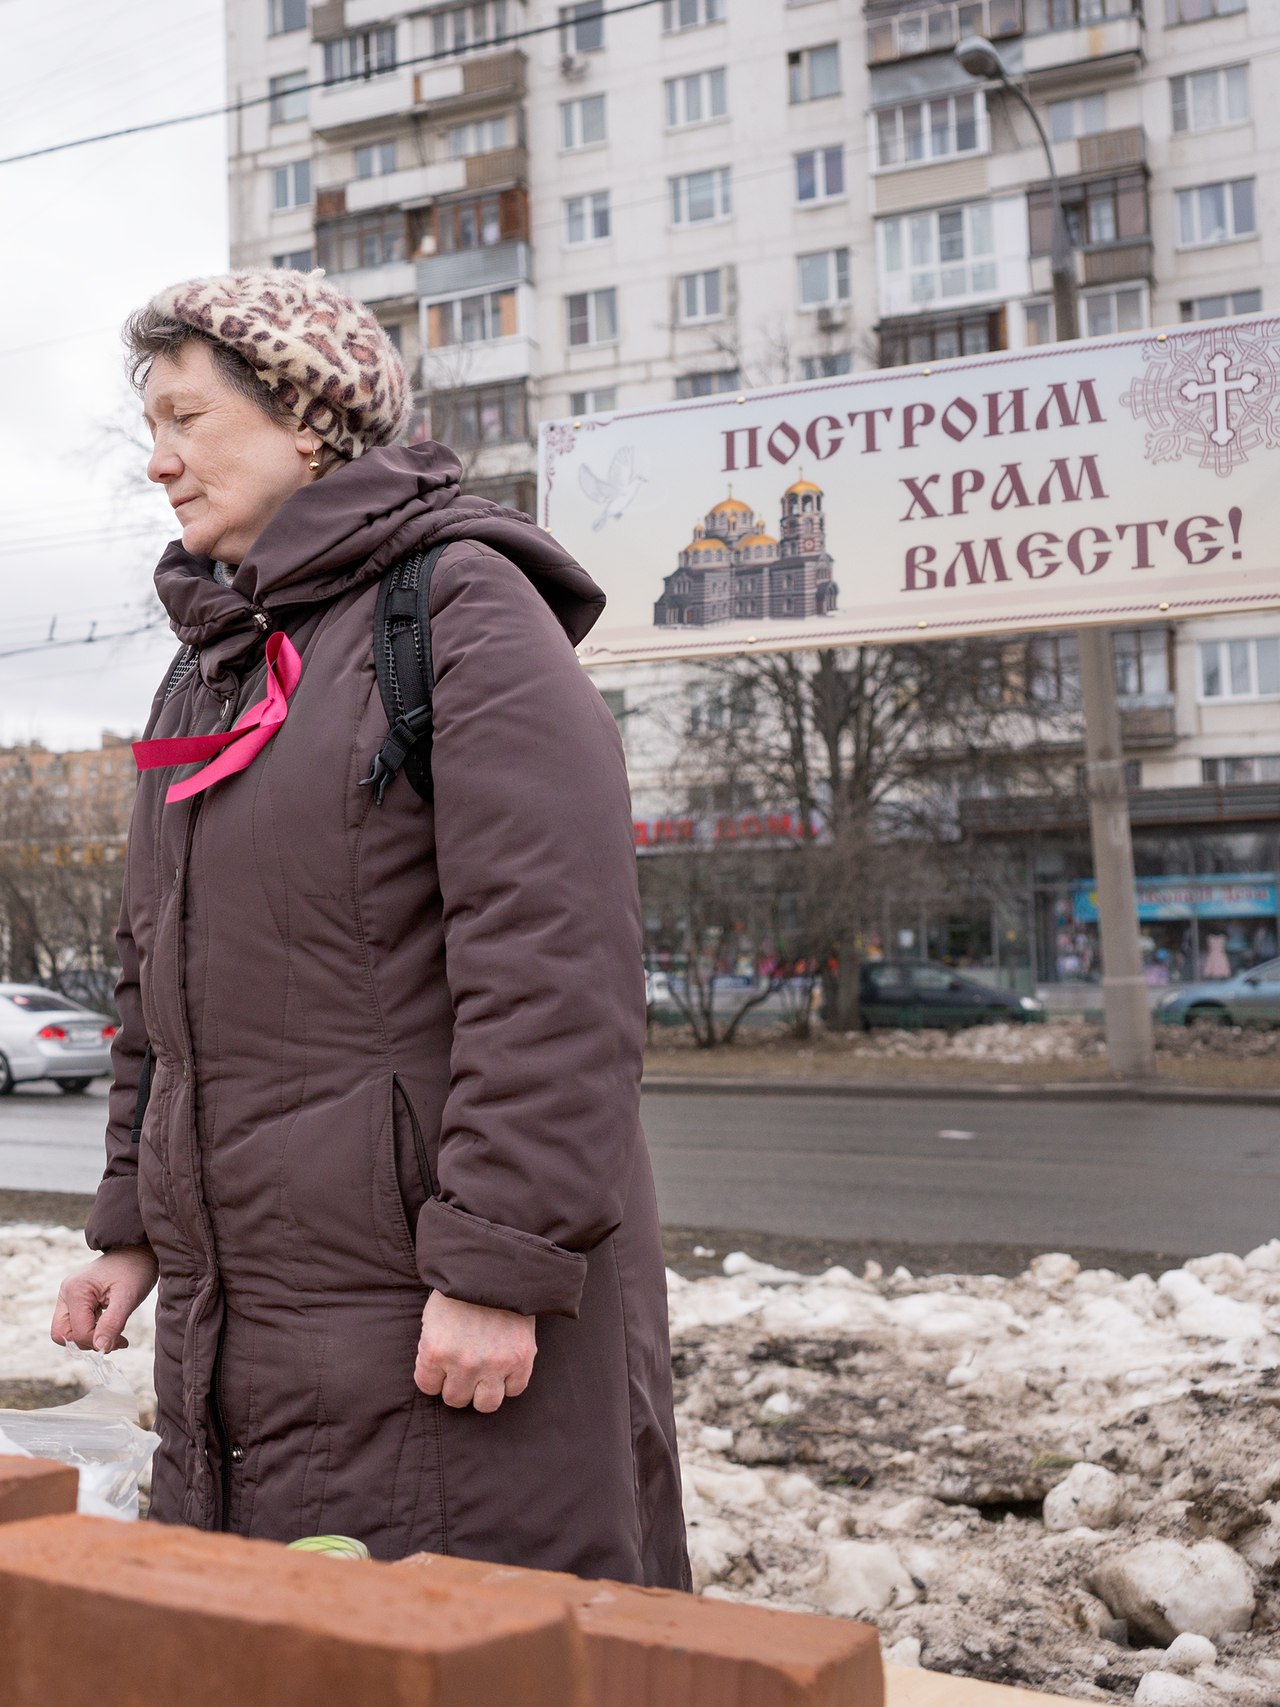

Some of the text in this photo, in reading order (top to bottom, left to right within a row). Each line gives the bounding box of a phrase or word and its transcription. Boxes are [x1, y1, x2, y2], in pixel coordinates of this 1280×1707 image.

[721, 378, 1107, 472] ПОСТРОИМ
[899, 453, 1110, 523] ХРАМ
[899, 506, 1244, 593] ВМЕСТЕ!
